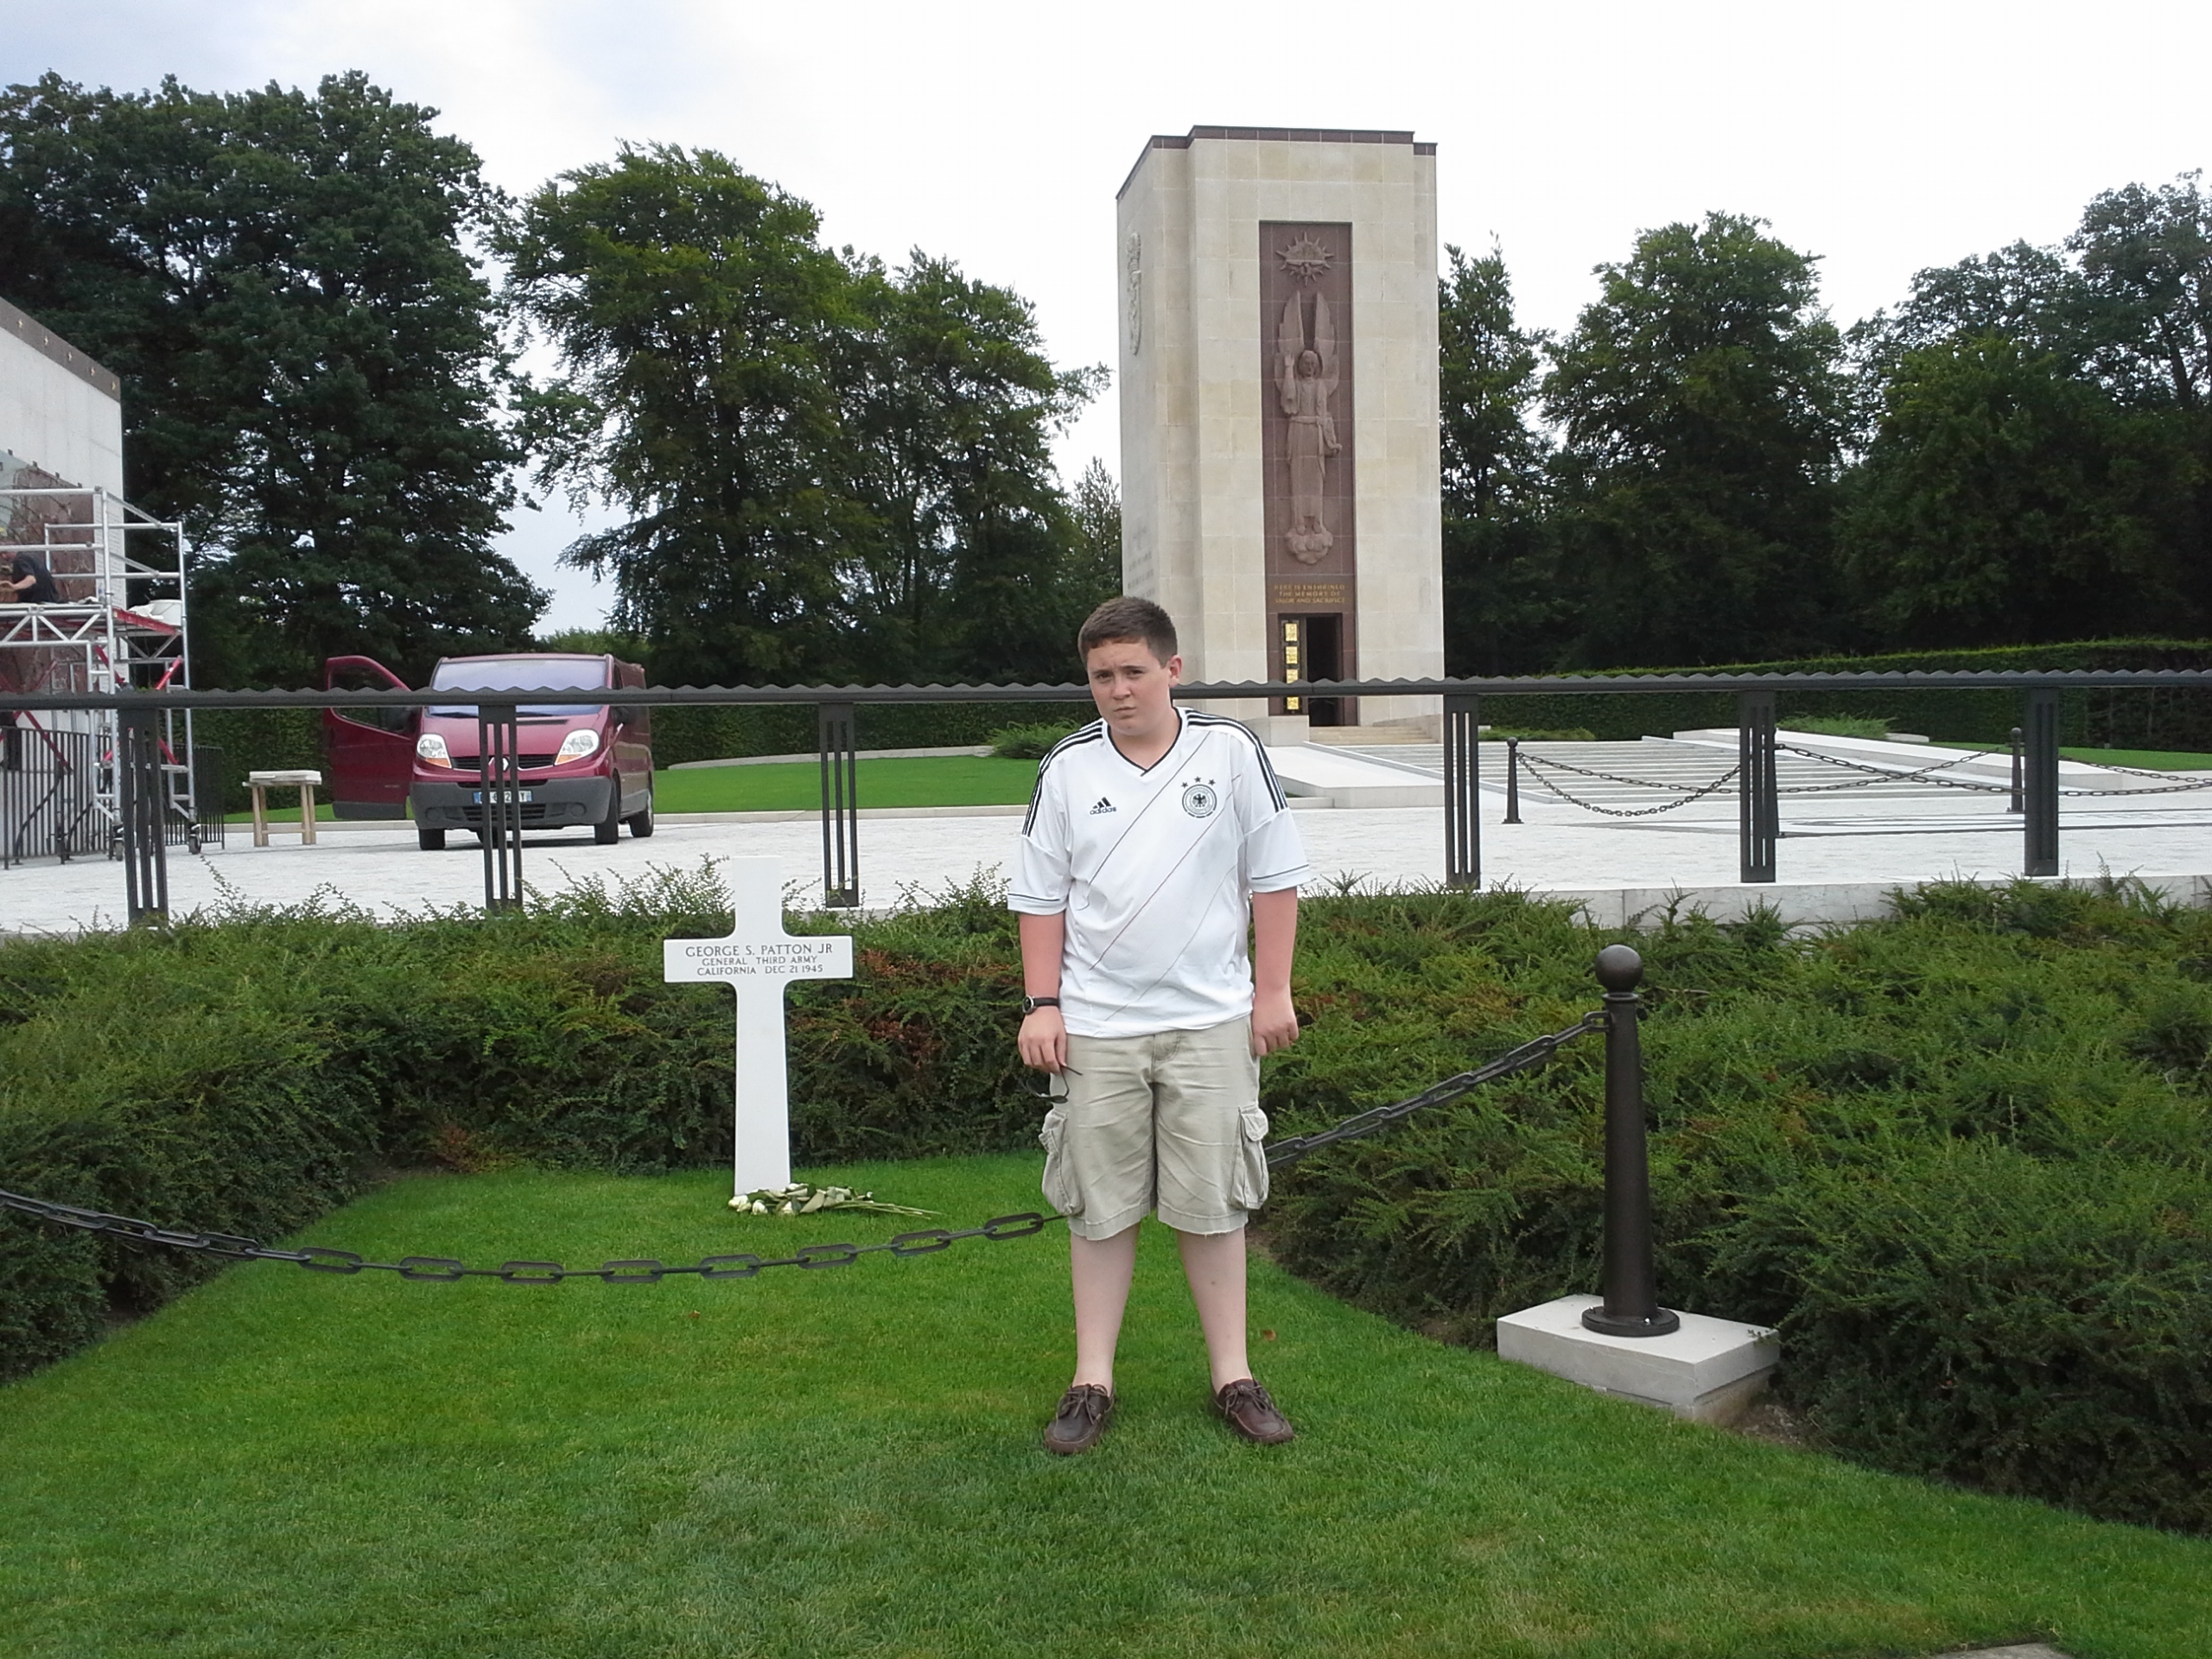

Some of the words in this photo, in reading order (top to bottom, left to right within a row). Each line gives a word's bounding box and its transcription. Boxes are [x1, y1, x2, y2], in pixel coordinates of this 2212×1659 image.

[1090, 804, 1117, 815] adidas
[685, 945, 740, 957] GEORGE
[745, 944, 755, 956] S.
[761, 944, 812, 955] PATTON
[817, 943, 833, 954] JR
[702, 957, 747, 966] GENERAL
[755, 956, 786, 964] THIRD
[790, 955, 818, 963] ARMY
[696, 966, 757, 976] CALIFORNIA
[765, 965, 785, 974] DEC
[789, 964, 798, 973] 21
[802, 963, 823, 973] 1945
